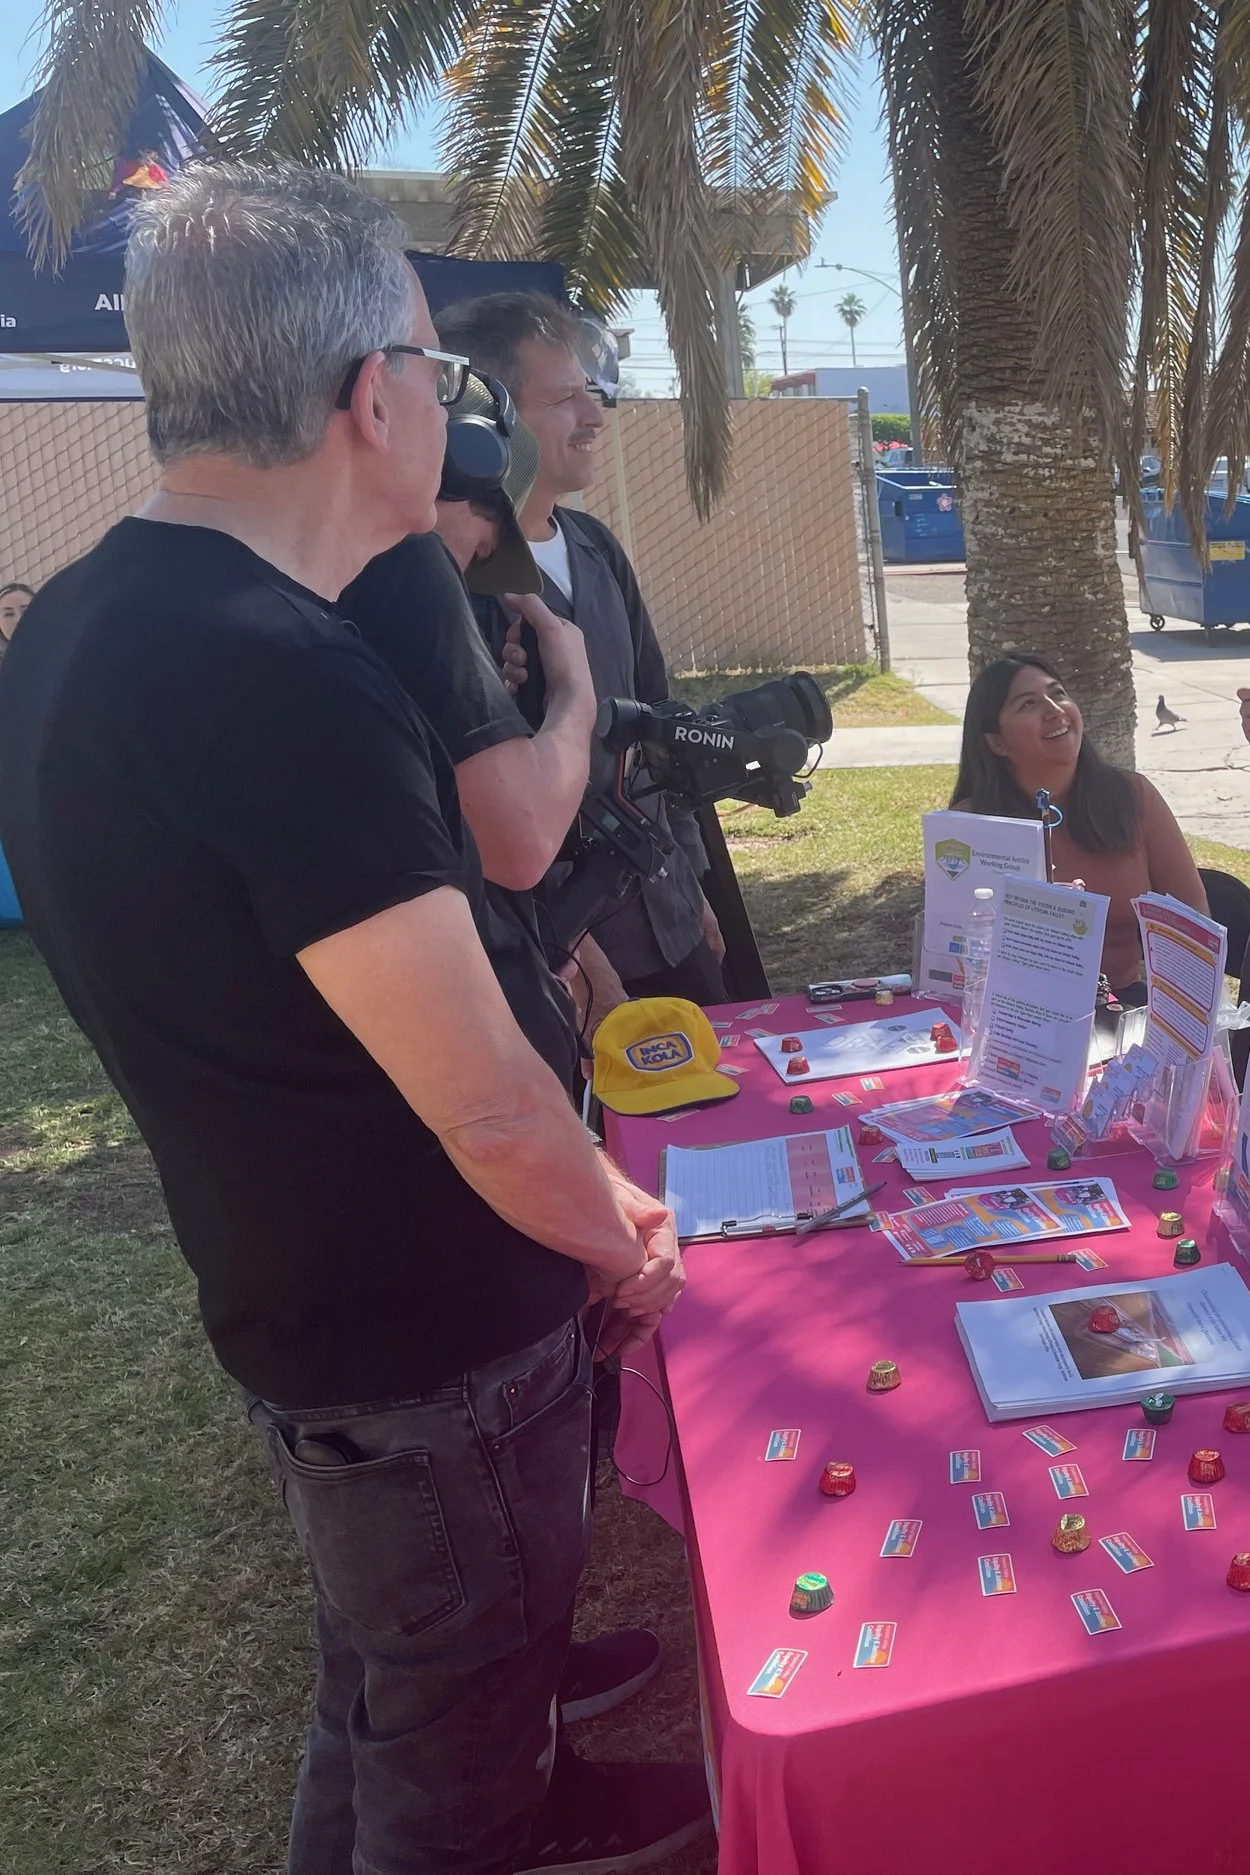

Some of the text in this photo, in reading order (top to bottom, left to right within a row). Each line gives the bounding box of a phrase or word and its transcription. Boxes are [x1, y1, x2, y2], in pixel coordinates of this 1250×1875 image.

[674, 726, 735, 750] RONIN
[971, 849, 1010, 861] Environmental
[980, 859, 1021, 872] Working Group
[640, 1041, 677, 1056] INCA
[641, 1049, 682, 1065] KOLA
